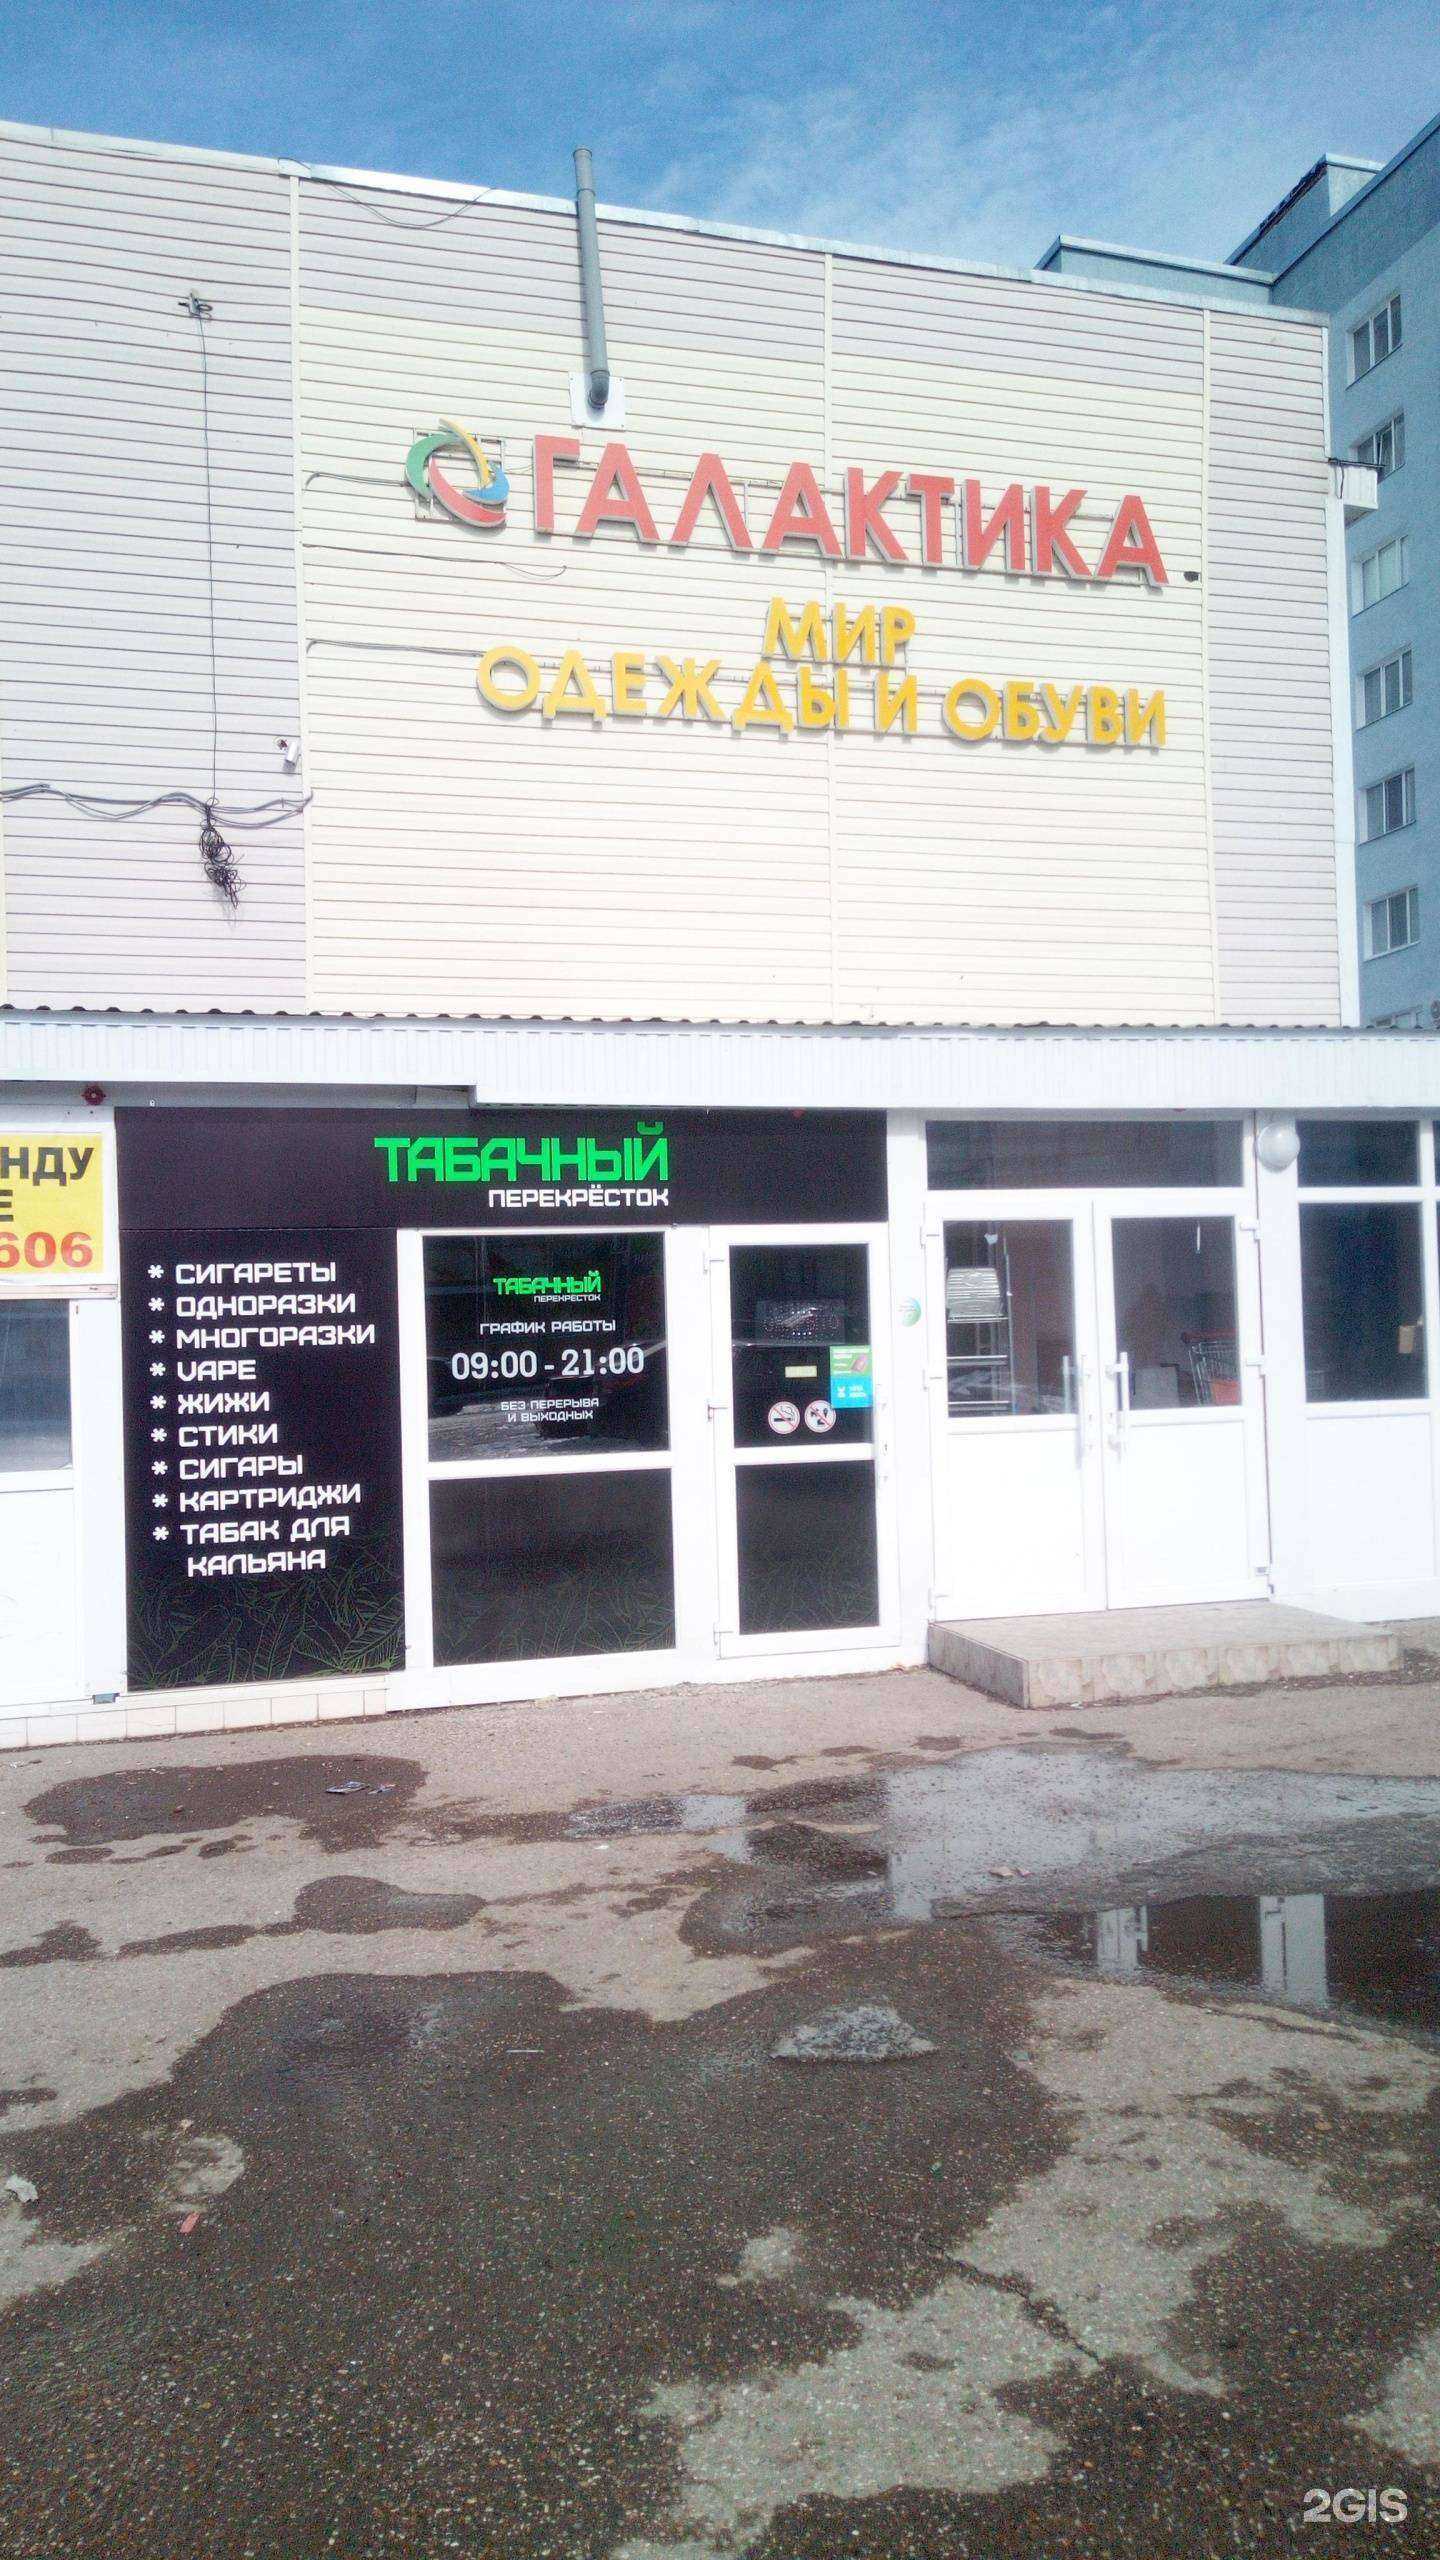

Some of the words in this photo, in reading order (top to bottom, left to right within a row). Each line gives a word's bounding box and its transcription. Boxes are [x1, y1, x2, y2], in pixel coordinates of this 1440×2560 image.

[533, 434, 1168, 588] ГАЛАКТИКА
[762, 597, 916, 668] МИР
[478, 645, 848, 735] ОДЕЖДЫ
[874, 674, 919, 734] И
[942, 678, 1167, 748] ОБУВИ
[375, 1121, 668, 1182] ТАБАЧНЫЙ
[488, 1184, 670, 1208] ПЕРЕКРЁСТОК
[175, 1262, 336, 1285] СИГАРЕТЫ
[493, 1270, 602, 1295] ТАБАЧНЫЙ
[176, 1294, 356, 1320] ОДНОРАЗКИ
[176, 1325, 376, 1349] МНОГОРАЗКИ
[480, 1321, 546, 1335] ГРАФИК
[551, 1319, 616, 1332] РАБОТЫ
[451, 1350, 538, 1379] 09:00
[561, 1347, 645, 1376] 21:00
[178, 1392, 270, 1413] ЖИЖИ
[500, 1400, 526, 1411] БЕЗ
[530, 1397, 600, 1410] ПЕРЕРЫВА
[507, 1413, 517, 1422] И
[521, 1409, 594, 1422] ВЫХОДНЫХ
[179, 1424, 278, 1447] СТИКИ
[179, 1456, 304, 1479] СИГАРЫ
[179, 1485, 361, 1512] КАРТРИДЖИ
[180, 1519, 280, 1544] ТАБАК
[290, 1516, 350, 1540] ДЛЯ
[187, 1549, 326, 1577] КАЛЬЯНА
